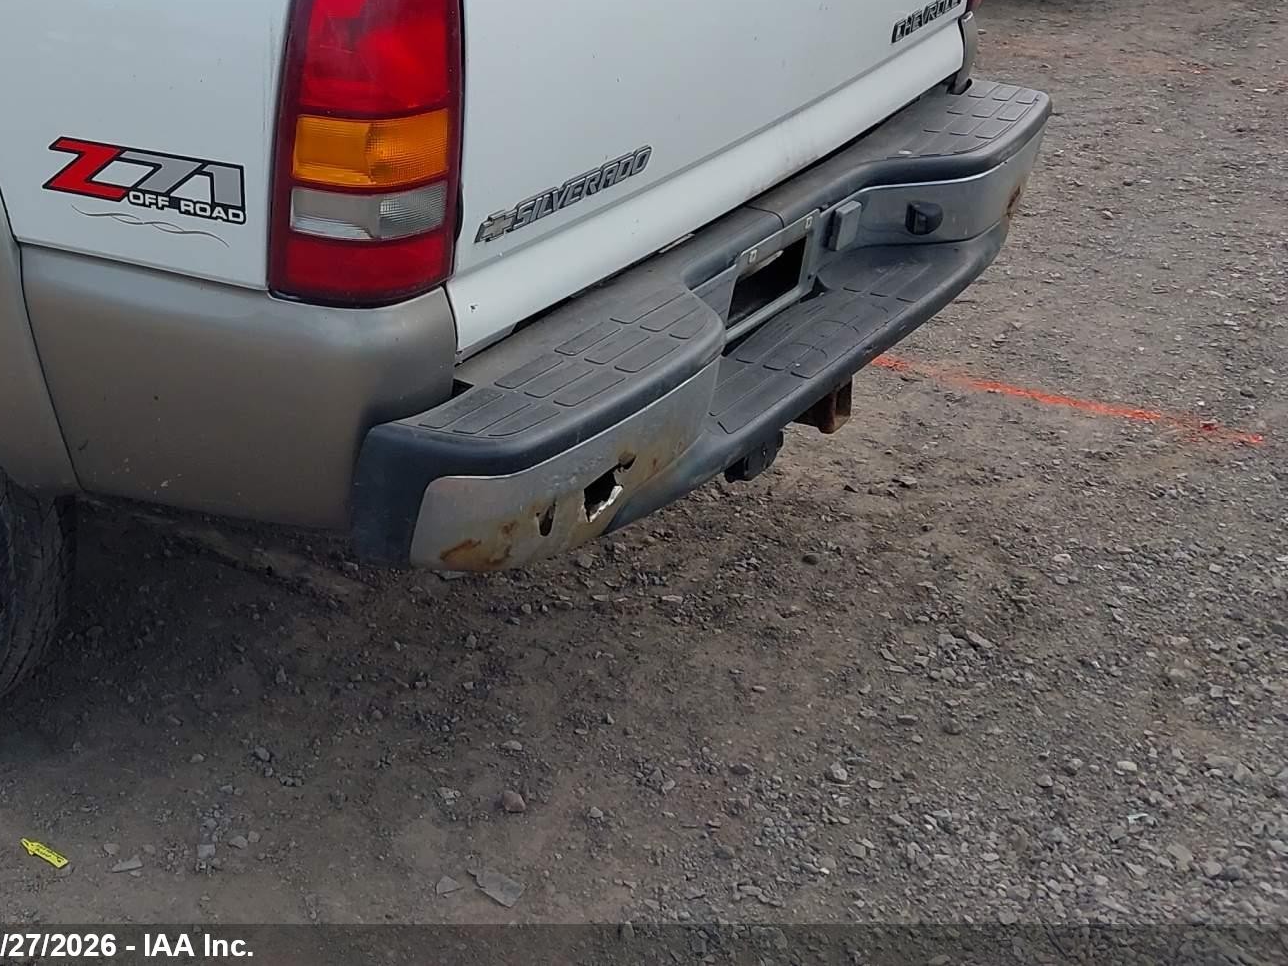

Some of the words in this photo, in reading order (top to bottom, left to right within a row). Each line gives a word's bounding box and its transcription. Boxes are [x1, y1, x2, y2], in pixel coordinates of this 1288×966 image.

[42, 136, 246, 208] Z71
[127, 190, 170, 209] OFF
[179, 202, 245, 222] ROAD
[513, 145, 652, 230] SILVERADO
